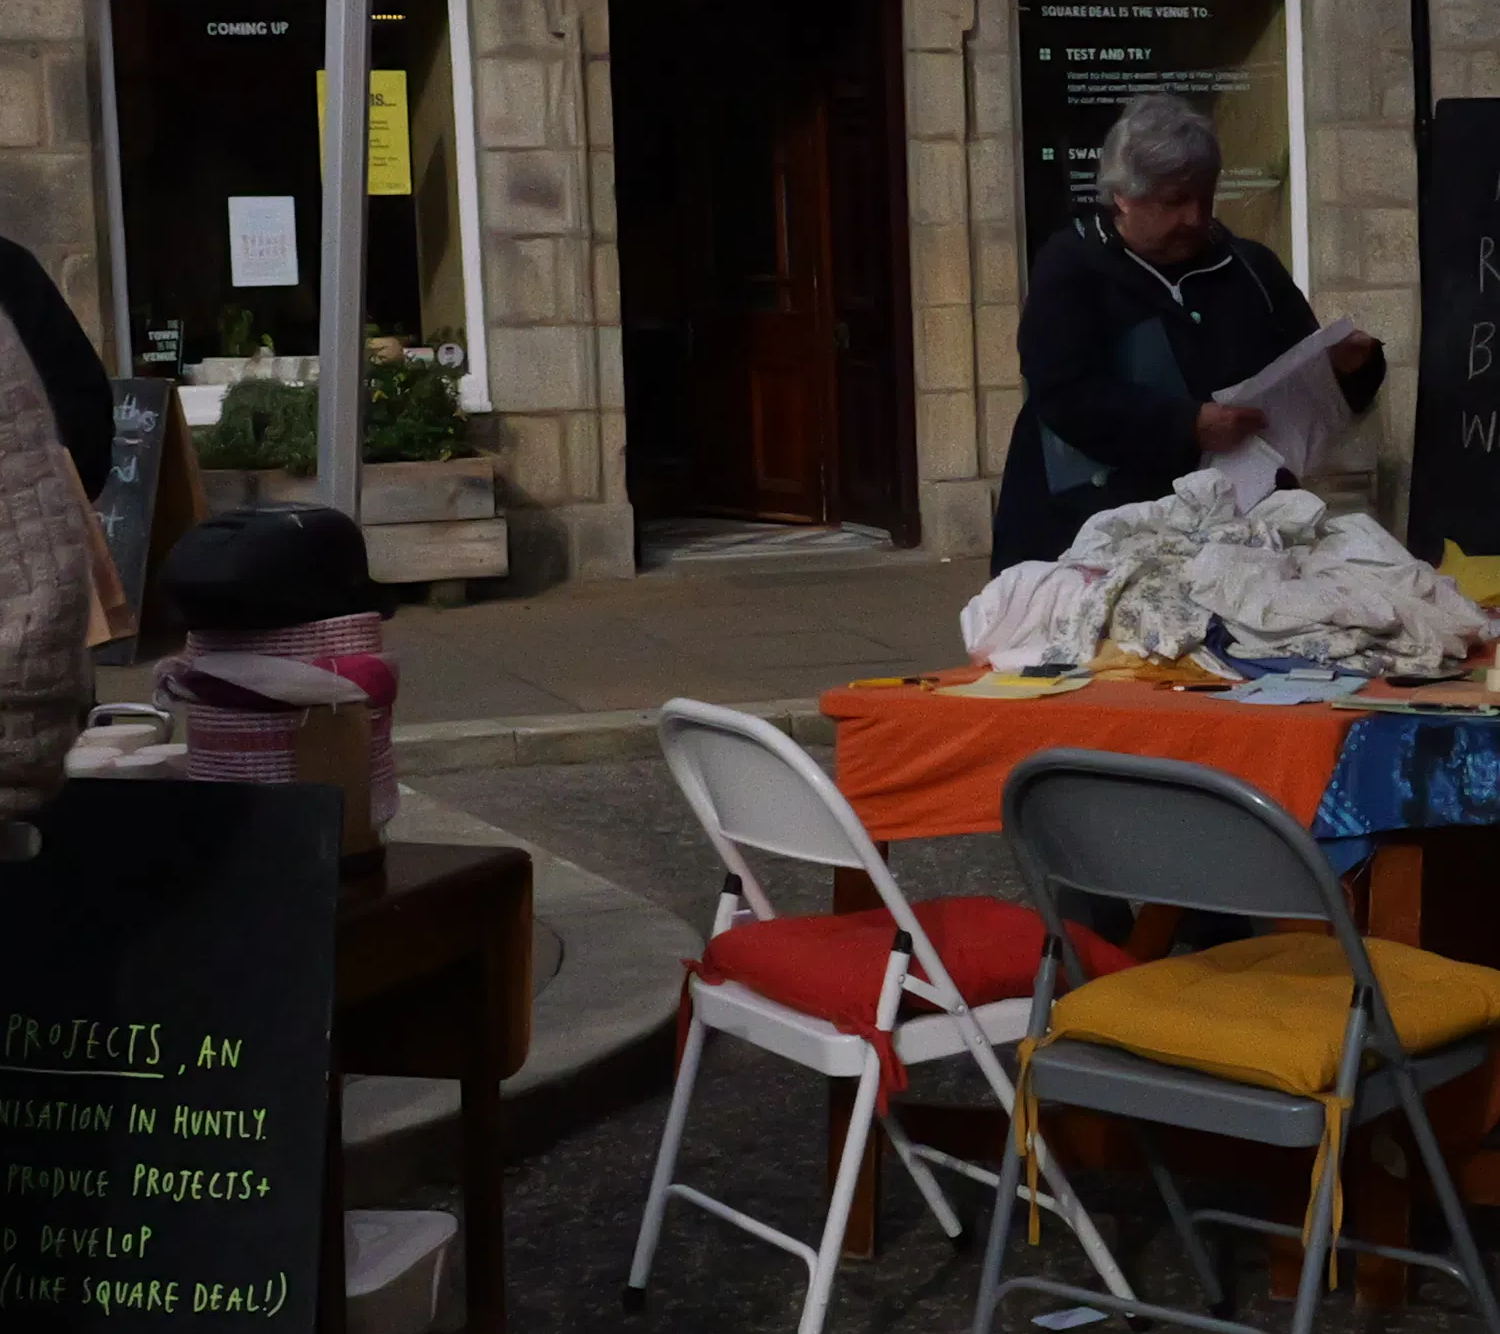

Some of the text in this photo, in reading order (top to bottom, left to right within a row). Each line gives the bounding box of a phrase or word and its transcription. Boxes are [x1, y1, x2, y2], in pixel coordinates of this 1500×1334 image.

[1041, 5, 1087, 17] SQUARE
[1089, 6, 1116, 17] DEAL
[1132, 6, 1152, 17] THE
[1155, 6, 1189, 18] VENUE
[206, 22, 289, 36] COMING UP
[1066, 48, 1151, 61] TEST AND TRY
[197, 1035, 243, 1070] AN
[129, 1104, 157, 1134] IN
[7, 1163, 109, 1199] PRODUCE
[41, 1225, 153, 1259] DEVELOP
[0, 1262, 68, 1310] (LIKE
[81, 1276, 181, 1316] SQUARE
[193, 1272, 288, 1318] DEAL!)
